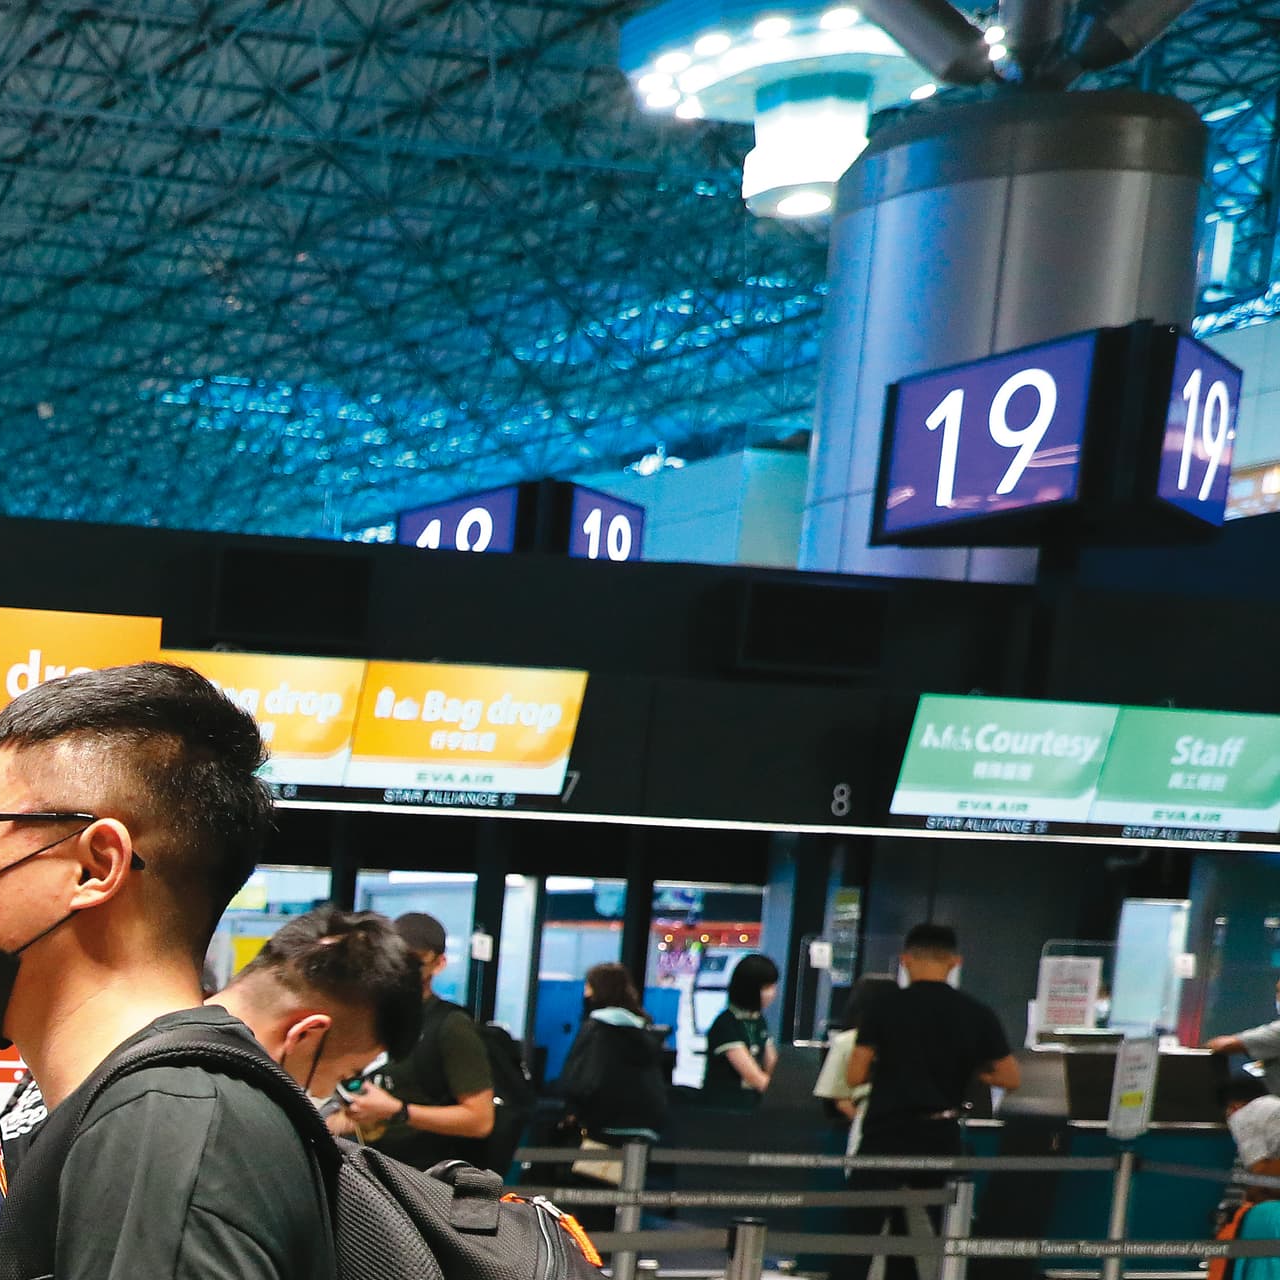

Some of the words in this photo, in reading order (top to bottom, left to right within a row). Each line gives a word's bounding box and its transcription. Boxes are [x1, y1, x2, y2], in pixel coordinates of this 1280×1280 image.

[925, 368, 1057, 508] 19
[1177, 368, 1229, 501] 19
[264, 682, 343, 724] drop
[423, 690, 483, 729] Bag
[487, 692, 562, 733] drop
[974, 724, 1101, 764] Courtesy
[1170, 736, 1245, 768] Staff
[831, 784, 851, 816] 8
[1125, 1242, 1189, 1256] International
